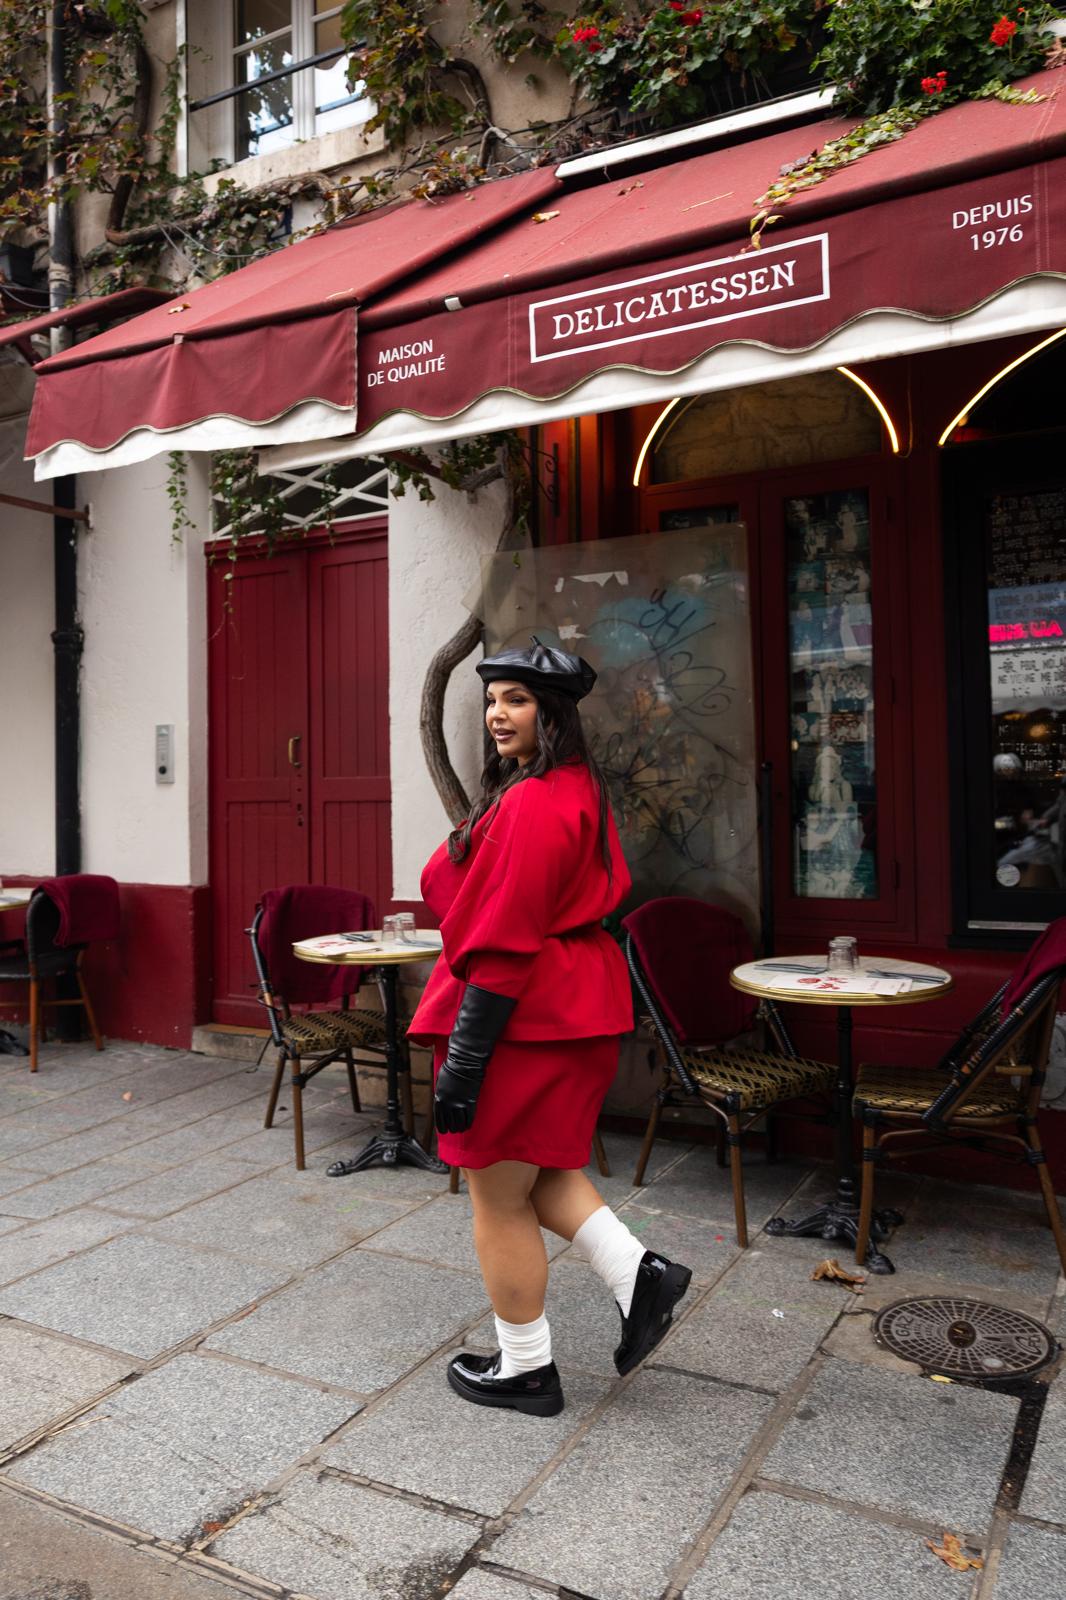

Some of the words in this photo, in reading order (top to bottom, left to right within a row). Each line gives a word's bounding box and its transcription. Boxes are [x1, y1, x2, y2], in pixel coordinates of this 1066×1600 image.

[952, 194, 1033, 230] DEPUIS
[970, 223, 1024, 251] 1976
[552, 260, 797, 340] DELICATESSEN
[378, 339, 433, 365] MAISON
[367, 370, 385, 388] DE
[387, 353, 446, 383] QUALITÉ
[895, 1314, 914, 1337] GAZ
